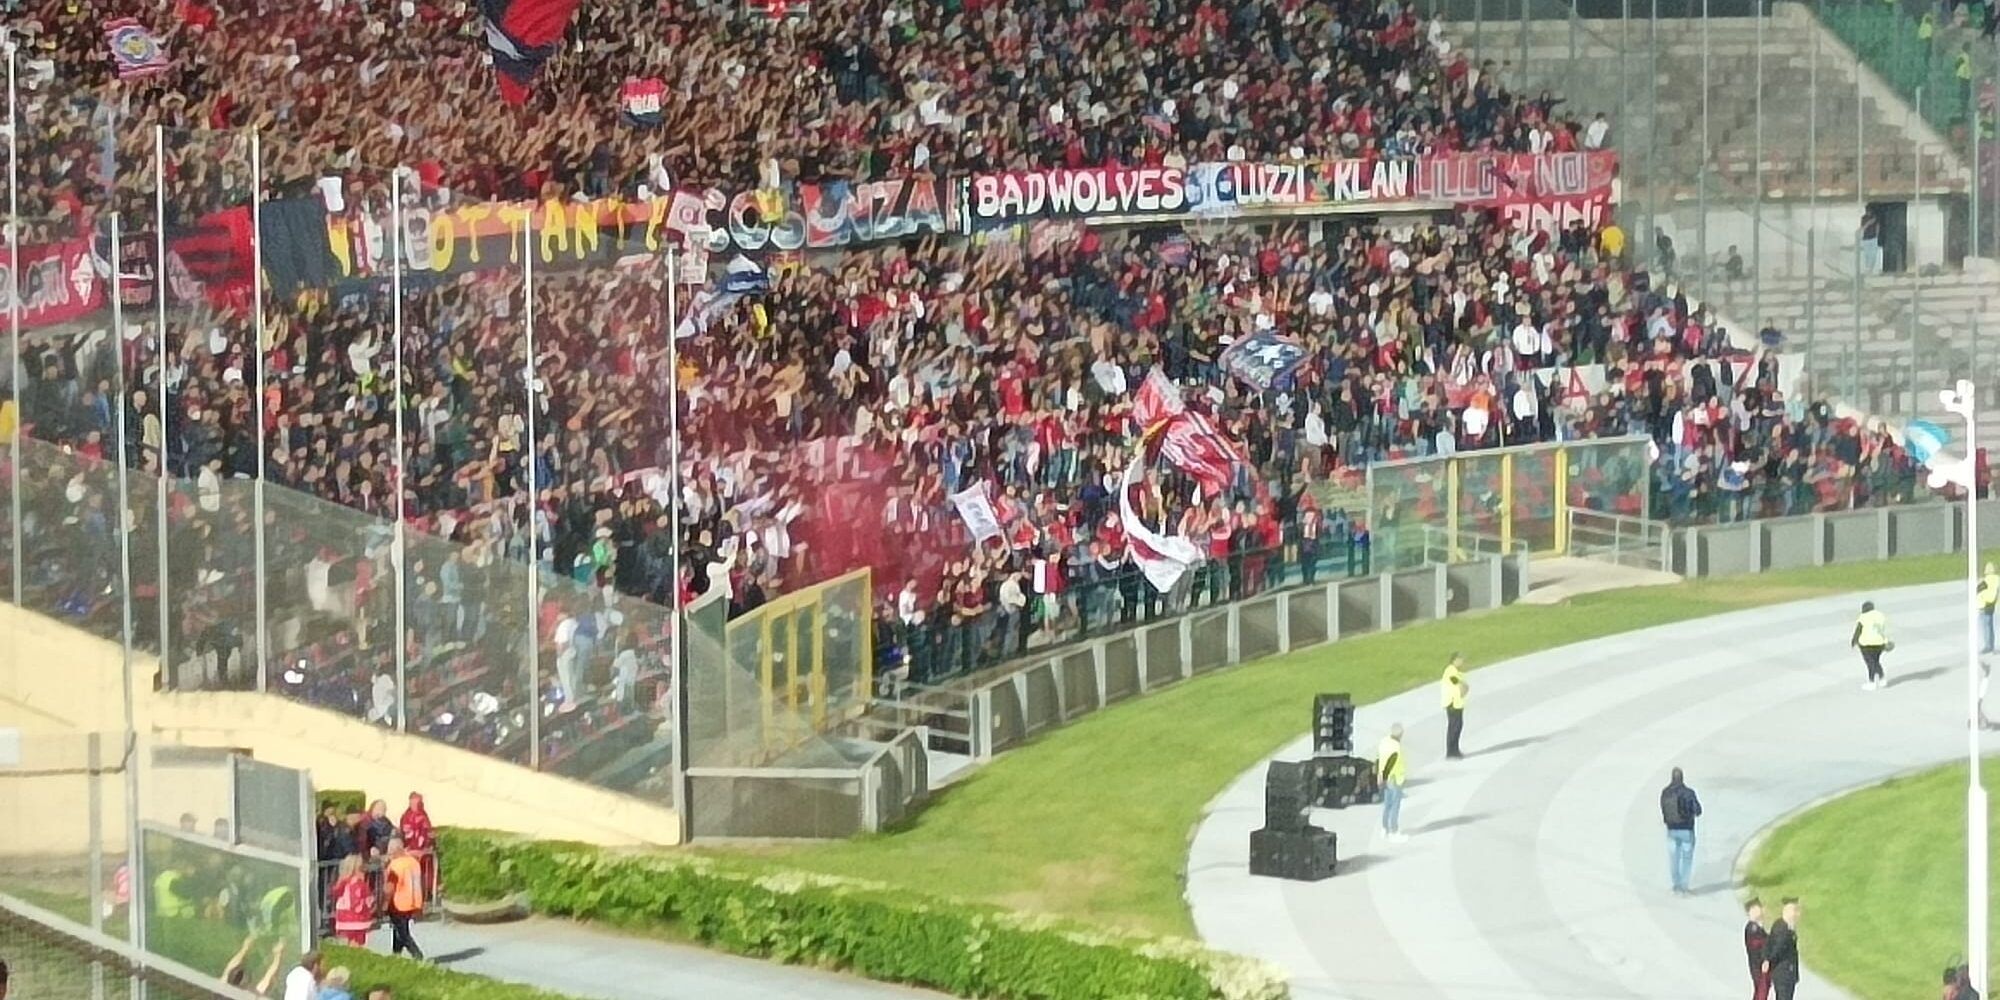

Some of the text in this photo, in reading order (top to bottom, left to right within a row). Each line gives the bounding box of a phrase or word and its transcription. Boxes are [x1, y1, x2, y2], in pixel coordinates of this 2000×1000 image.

[1234, 163, 1305, 203] LUZZI
[1334, 160, 1408, 200] KLAN
[1535, 152, 1587, 196] NOI
